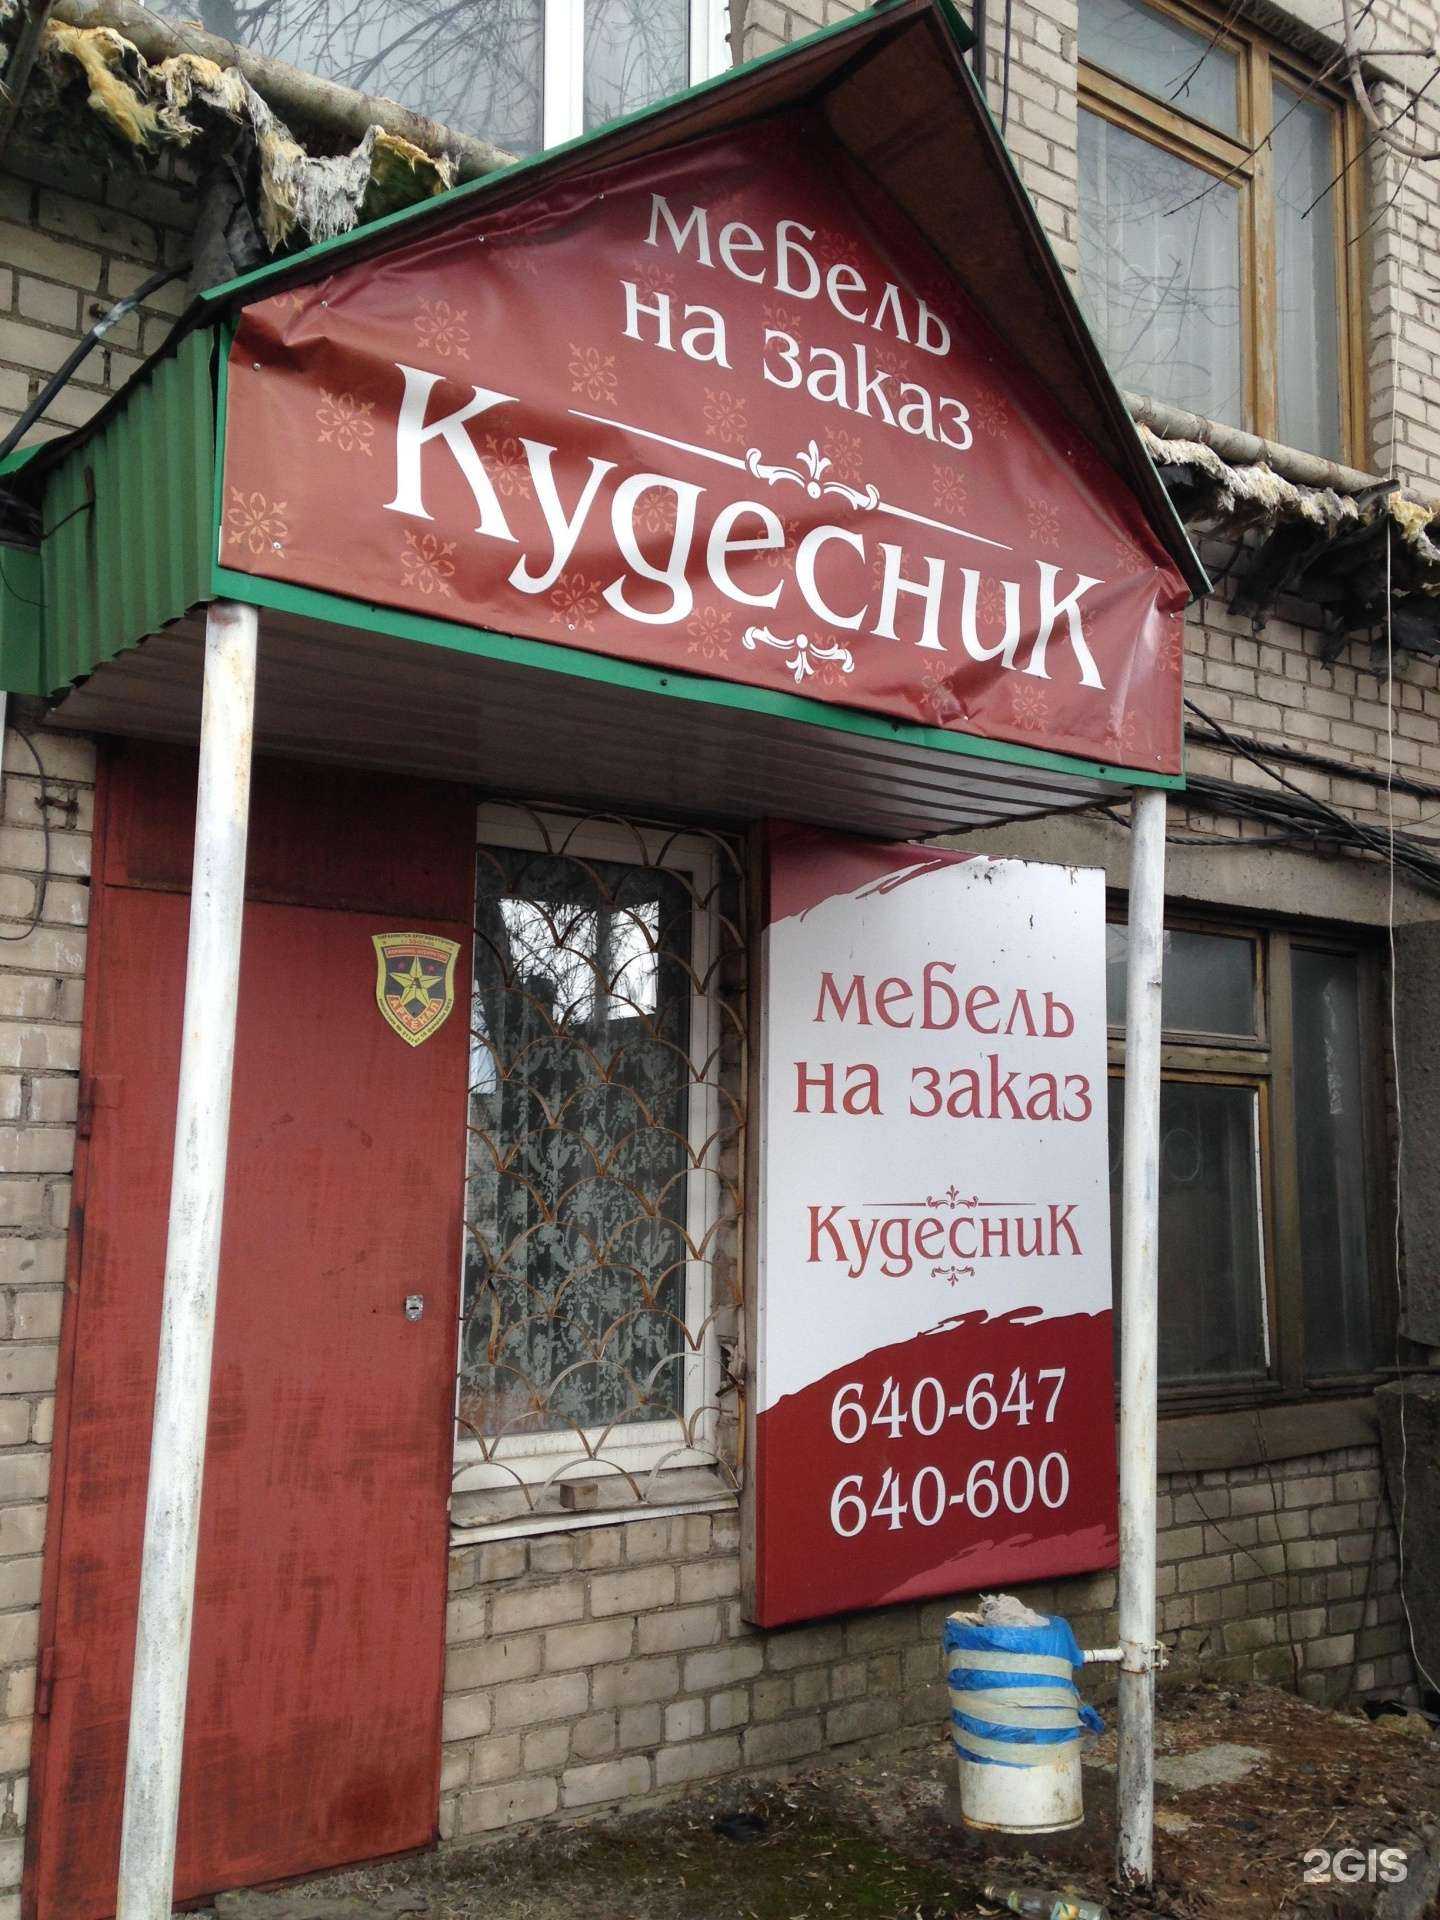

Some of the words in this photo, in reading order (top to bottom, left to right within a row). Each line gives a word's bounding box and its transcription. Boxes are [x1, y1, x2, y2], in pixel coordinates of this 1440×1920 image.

[620, 280, 733, 369] на
[763, 328, 975, 452] заказ
[389, 999, 441, 1029] АРСЕНАЛ
[793, 1062, 884, 1115] на
[909, 1054, 1093, 1122] заказ
[830, 1367, 1067, 1445] 640-647
[829, 1451, 1071, 1538] 640-600
